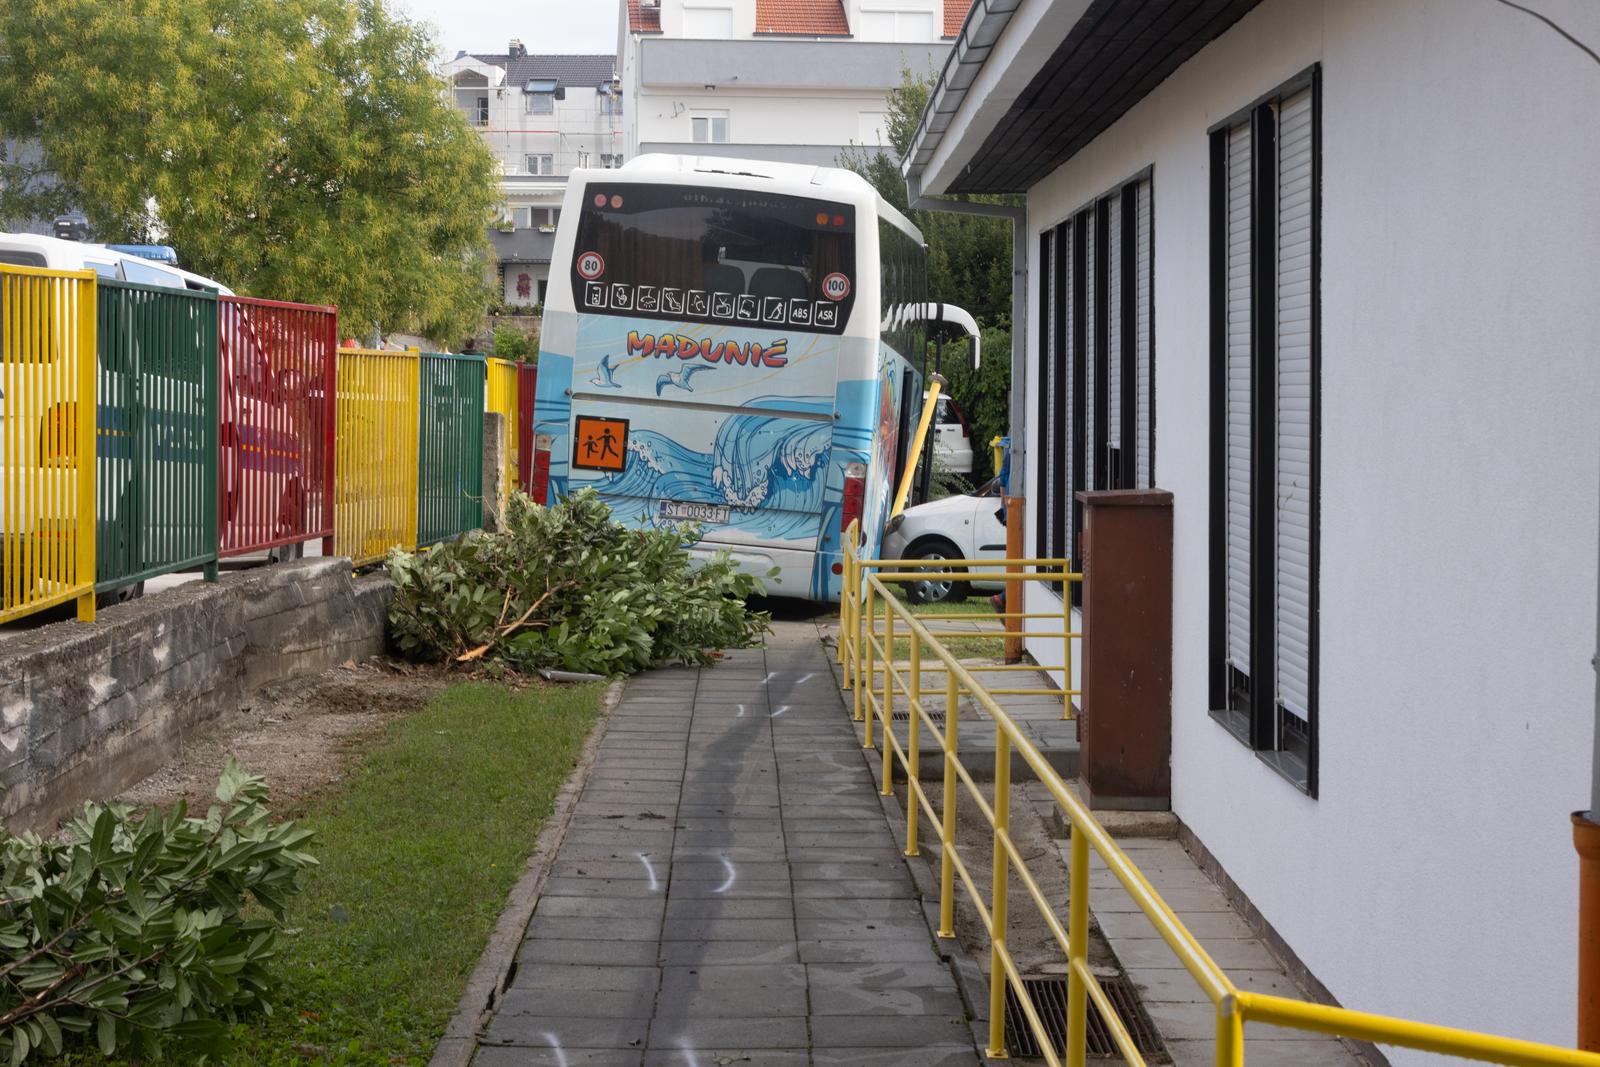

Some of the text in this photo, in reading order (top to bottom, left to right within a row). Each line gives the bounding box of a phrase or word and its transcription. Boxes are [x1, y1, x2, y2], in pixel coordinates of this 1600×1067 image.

[584, 260, 598, 271] 80
[828, 280, 844, 291] 100
[792, 309, 808, 319] ABS
[818, 310, 833, 321] ASR
[627, 330, 788, 368] MADUNIĆ
[667, 503, 681, 515] ST
